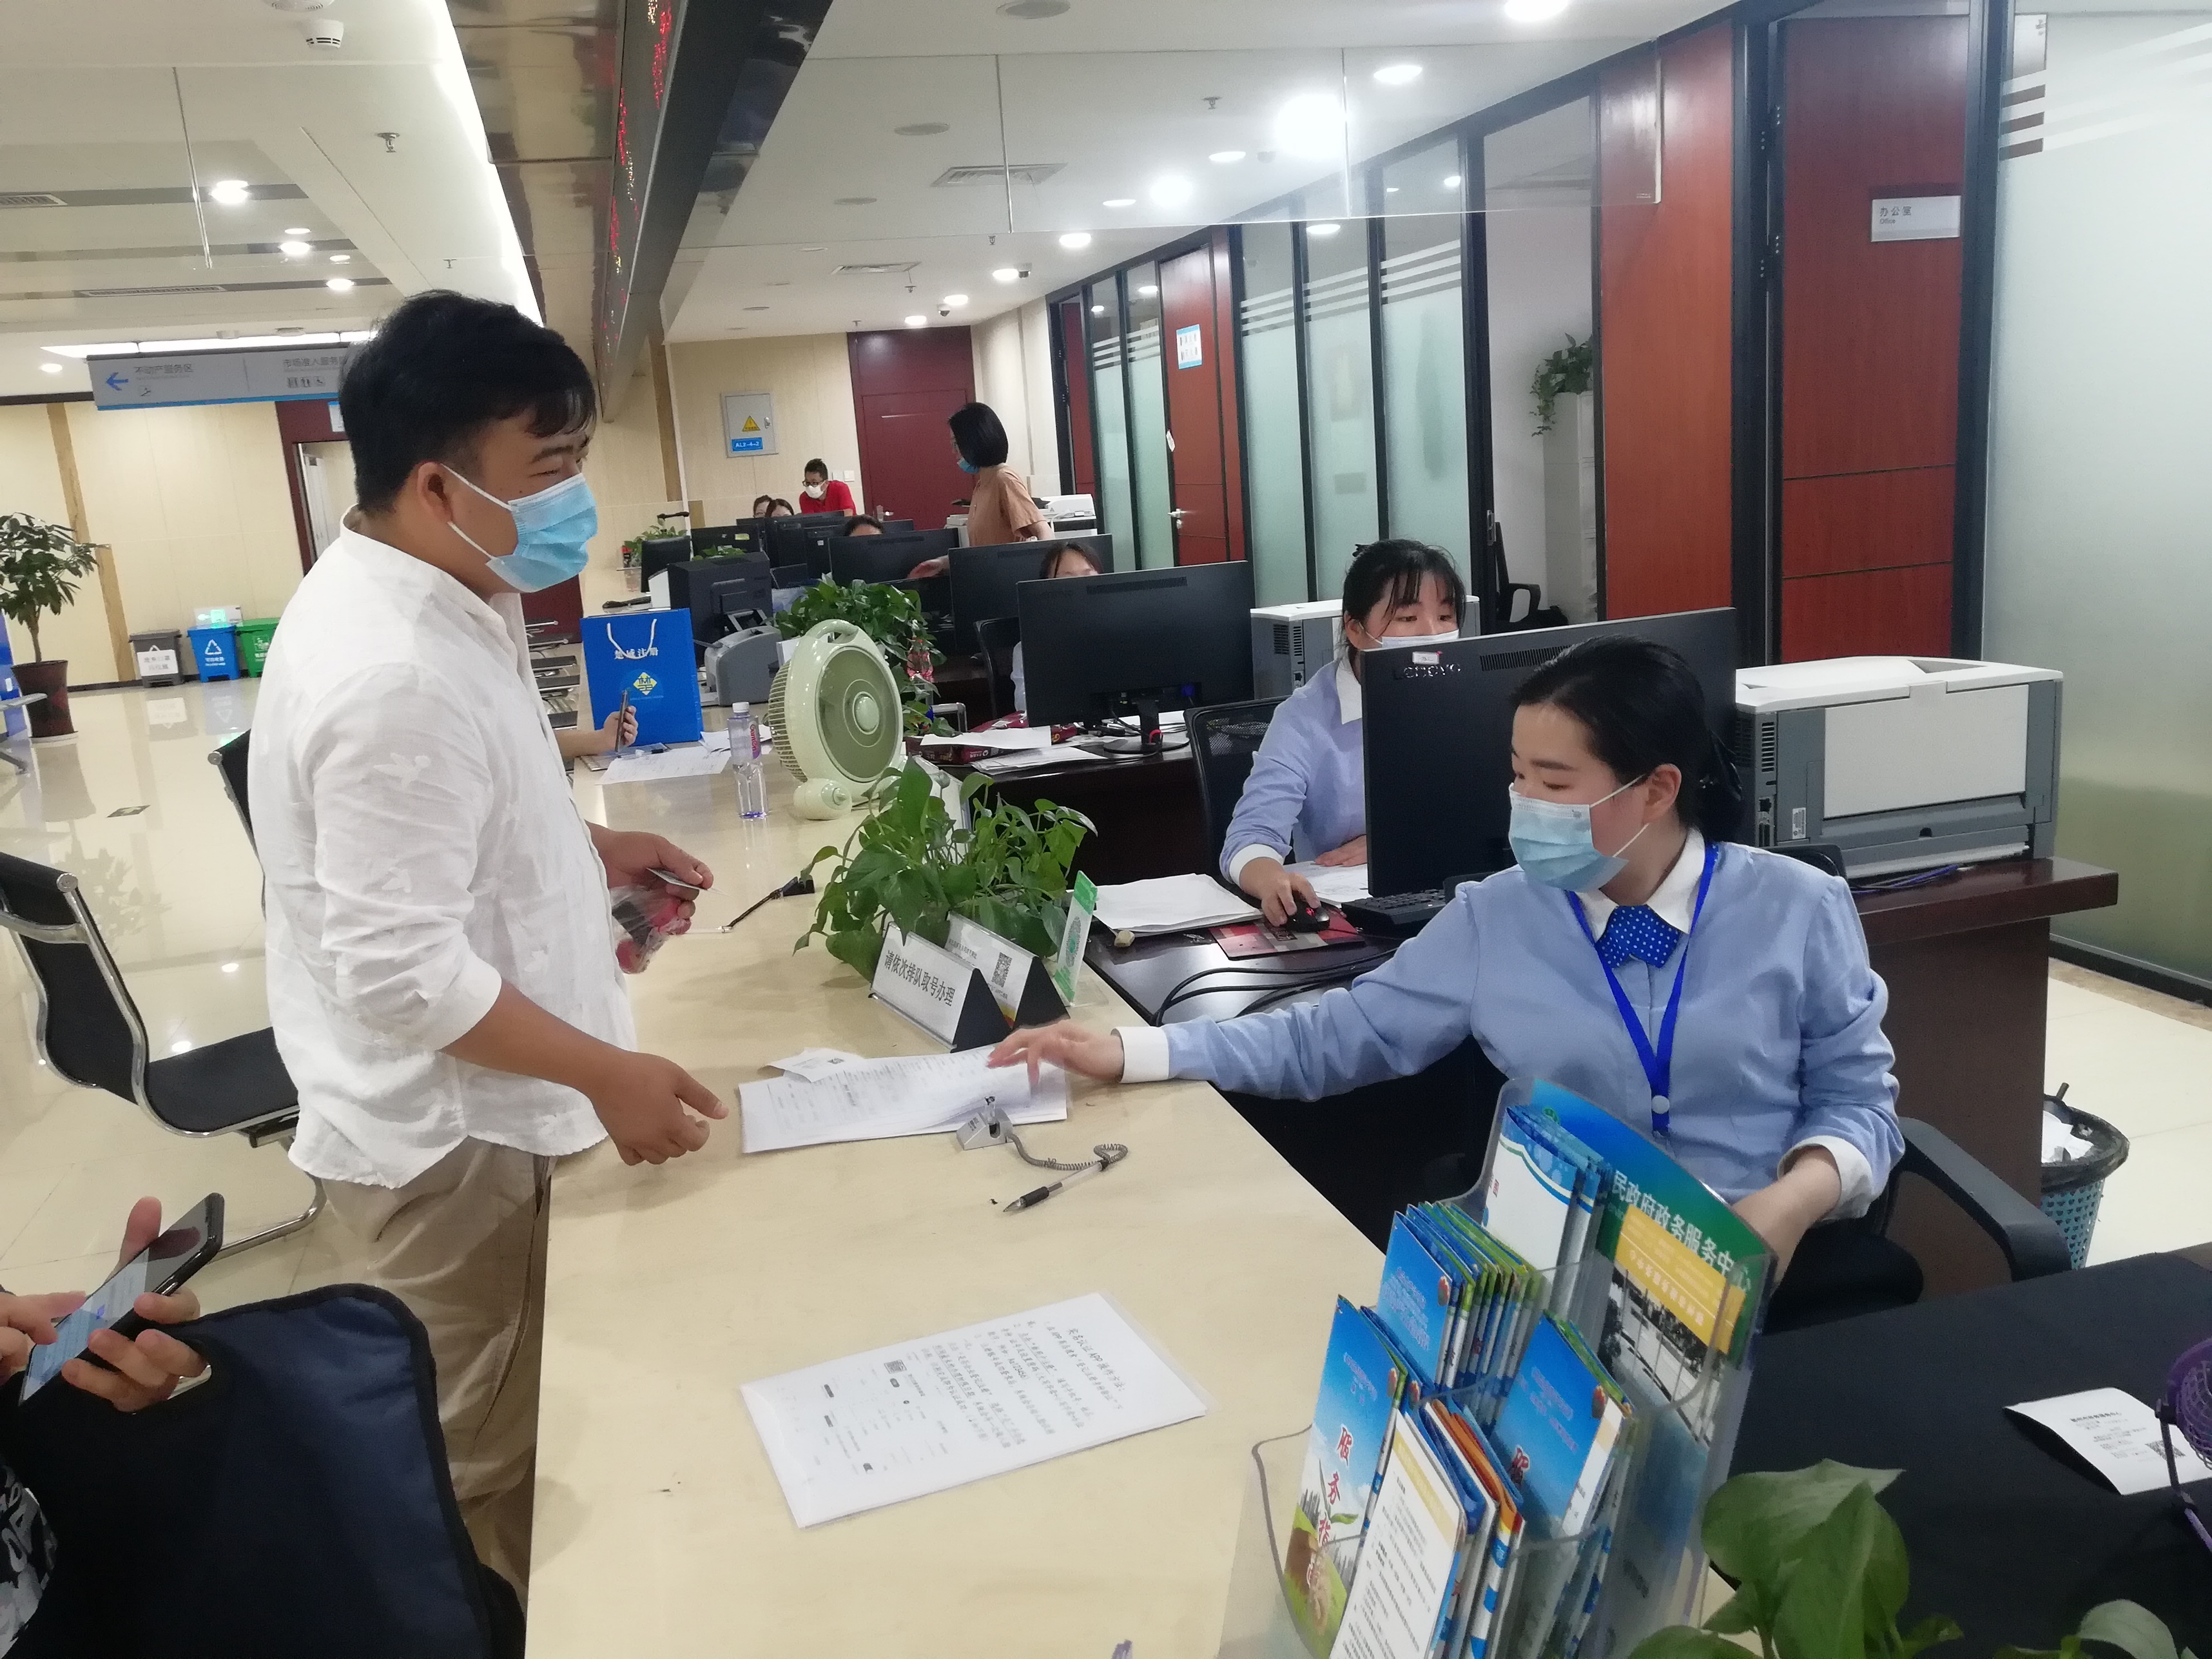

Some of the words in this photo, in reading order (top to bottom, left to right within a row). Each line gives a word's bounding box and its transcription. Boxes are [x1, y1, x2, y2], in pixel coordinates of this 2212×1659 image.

[1879, 206, 1912, 217] 办公室
[884, 949, 955, 1007] 请依次排队取号办理
